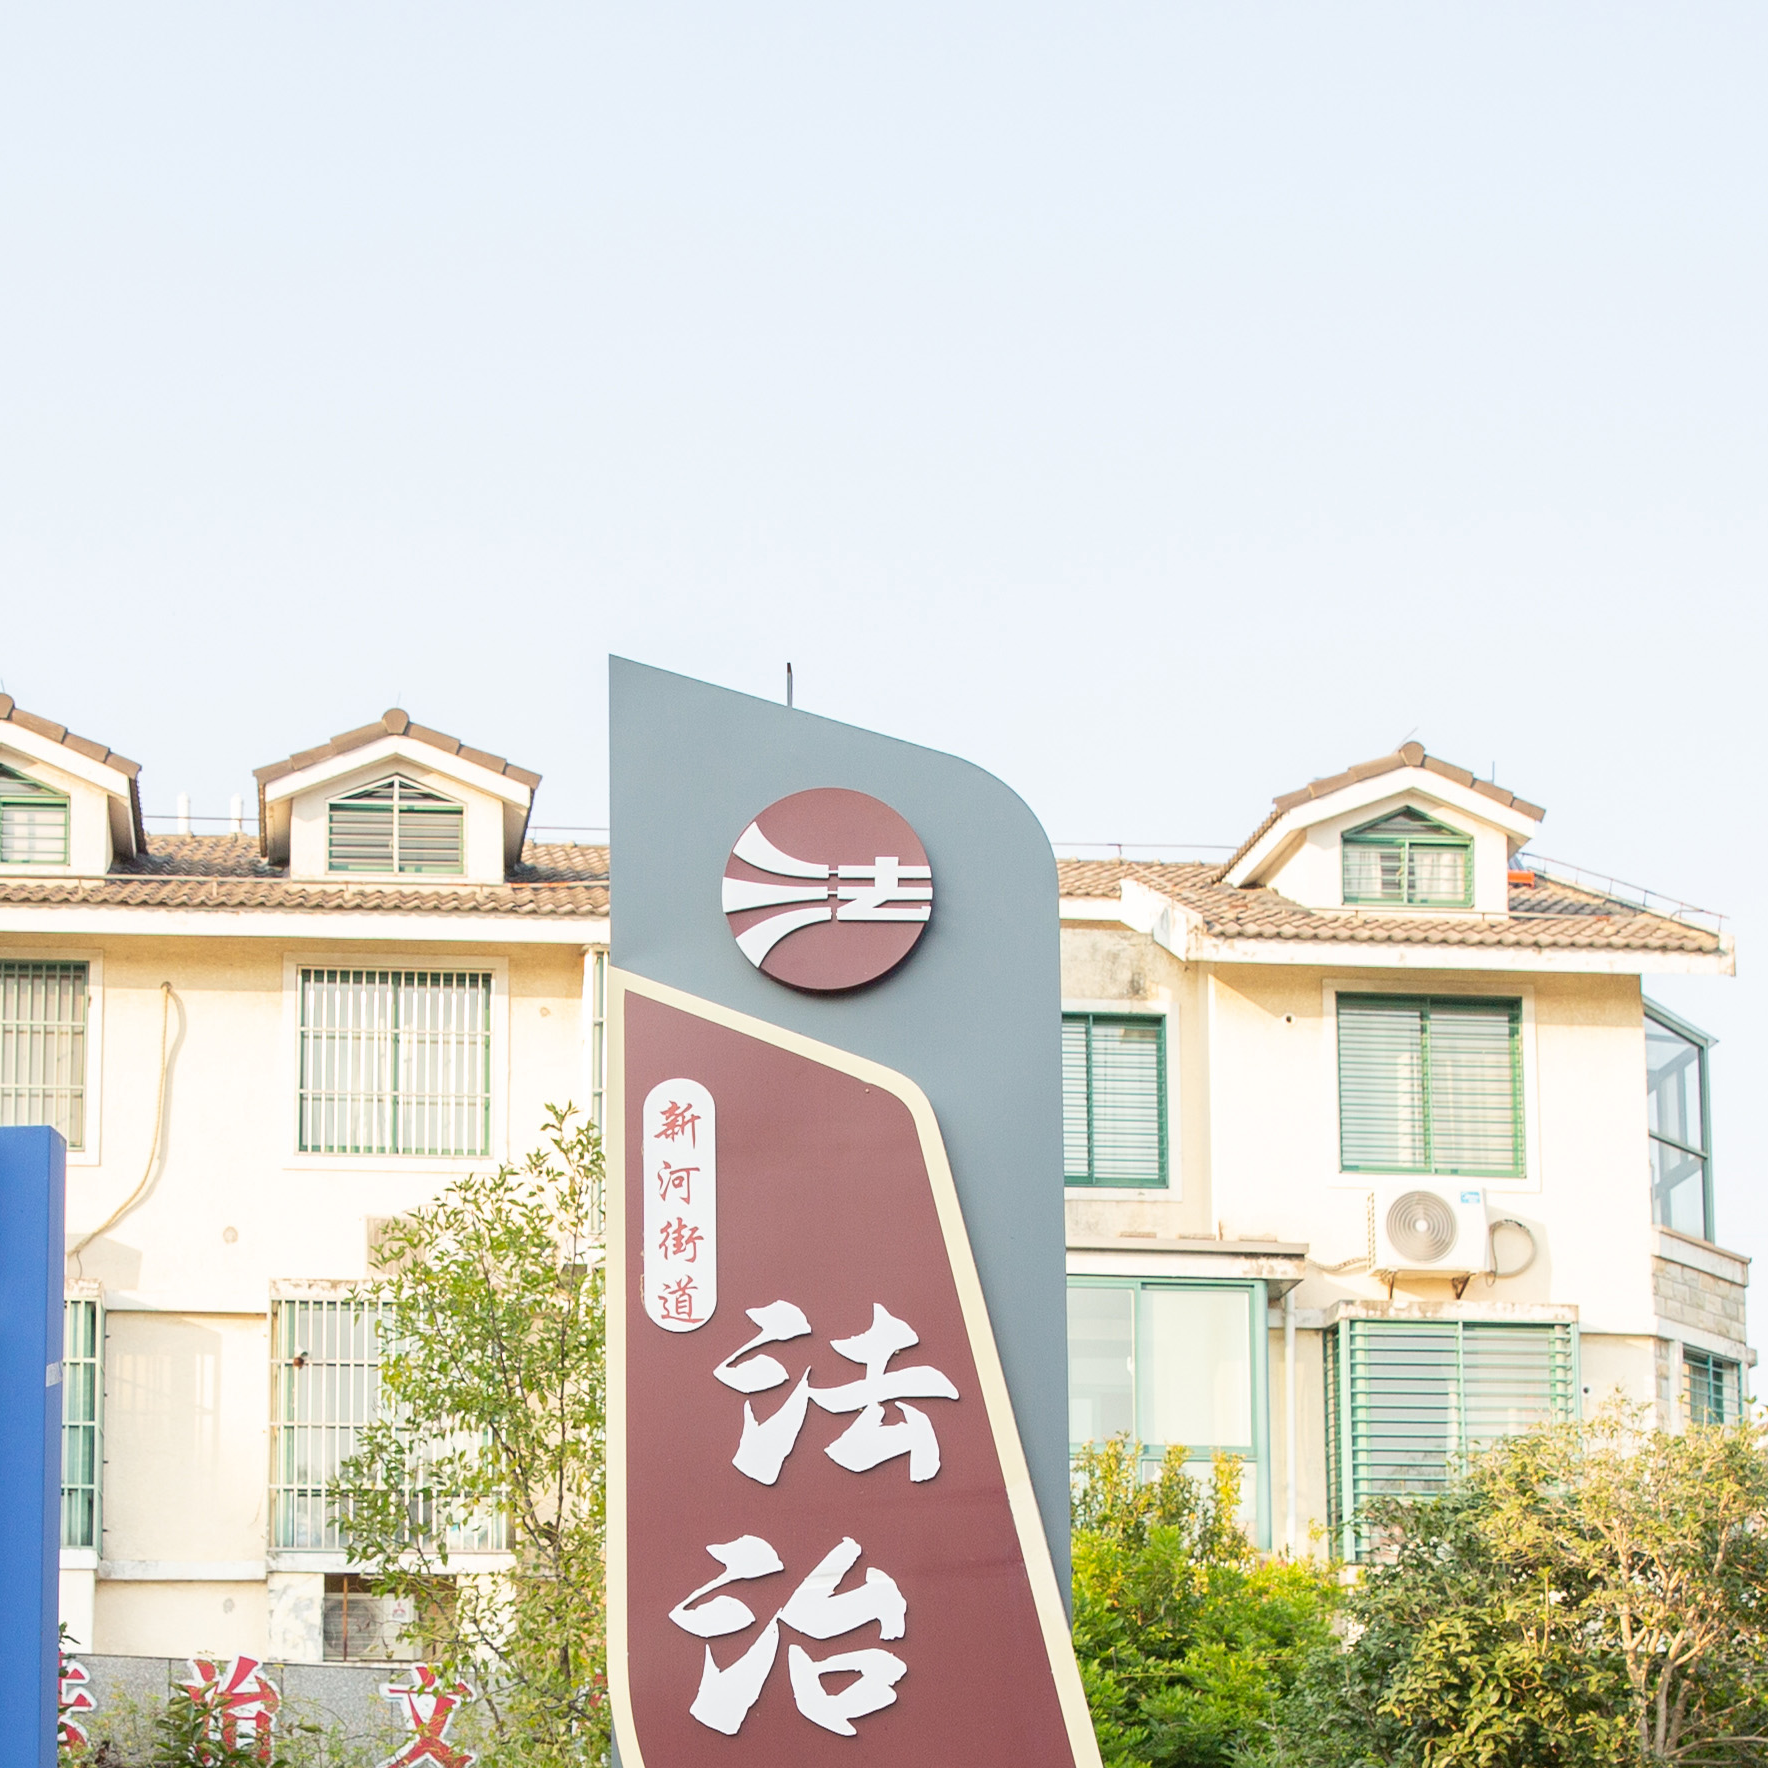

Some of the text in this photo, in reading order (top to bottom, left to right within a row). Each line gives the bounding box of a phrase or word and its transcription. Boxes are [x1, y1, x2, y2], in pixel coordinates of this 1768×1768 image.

[653, 1100, 705, 1325] 新河街道
[669, 1300, 960, 1737] 法治
